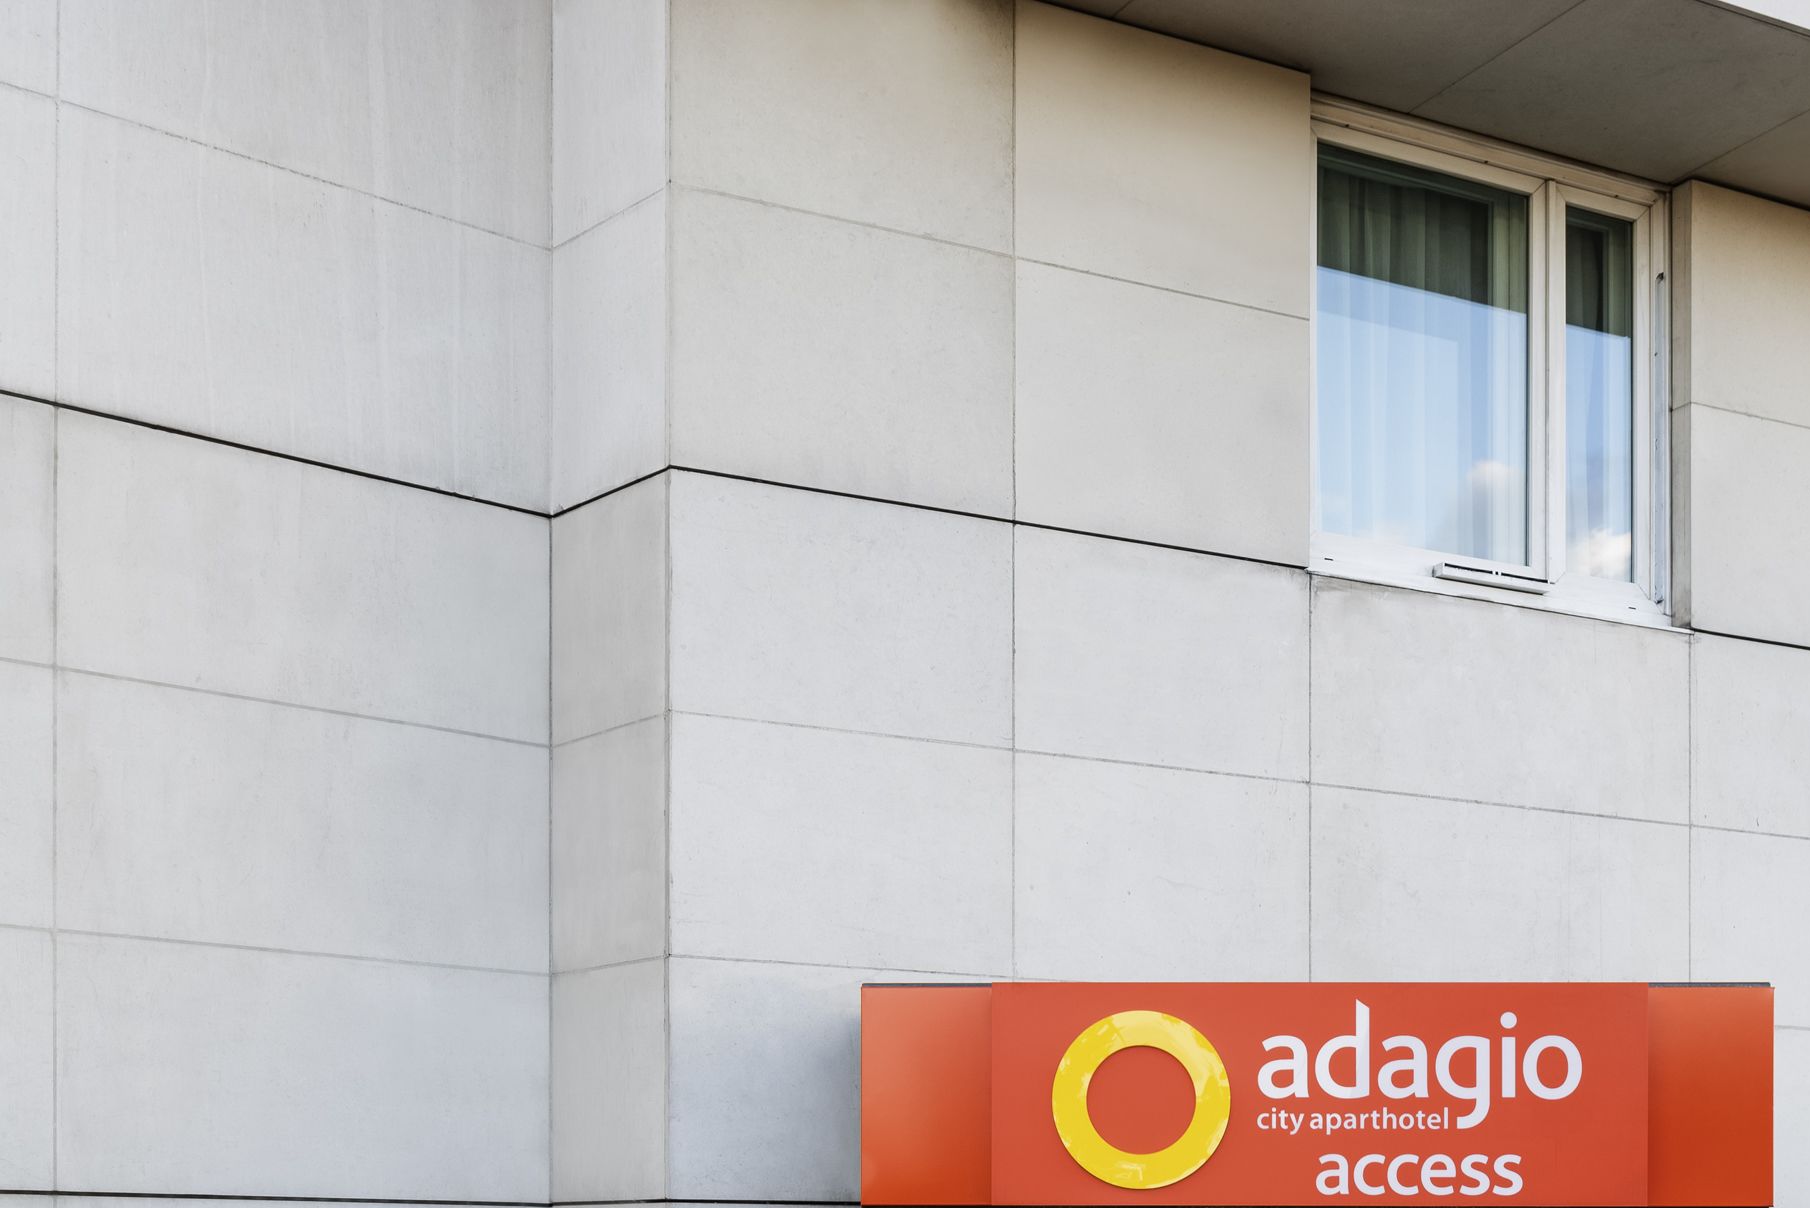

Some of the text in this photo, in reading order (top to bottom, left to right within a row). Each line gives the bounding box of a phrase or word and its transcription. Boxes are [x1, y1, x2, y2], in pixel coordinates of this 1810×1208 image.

[1256, 999, 1583, 1130] adagio
[1257, 1106, 1449, 1135] city aparthotel
[1315, 1153, 1524, 1196] access
